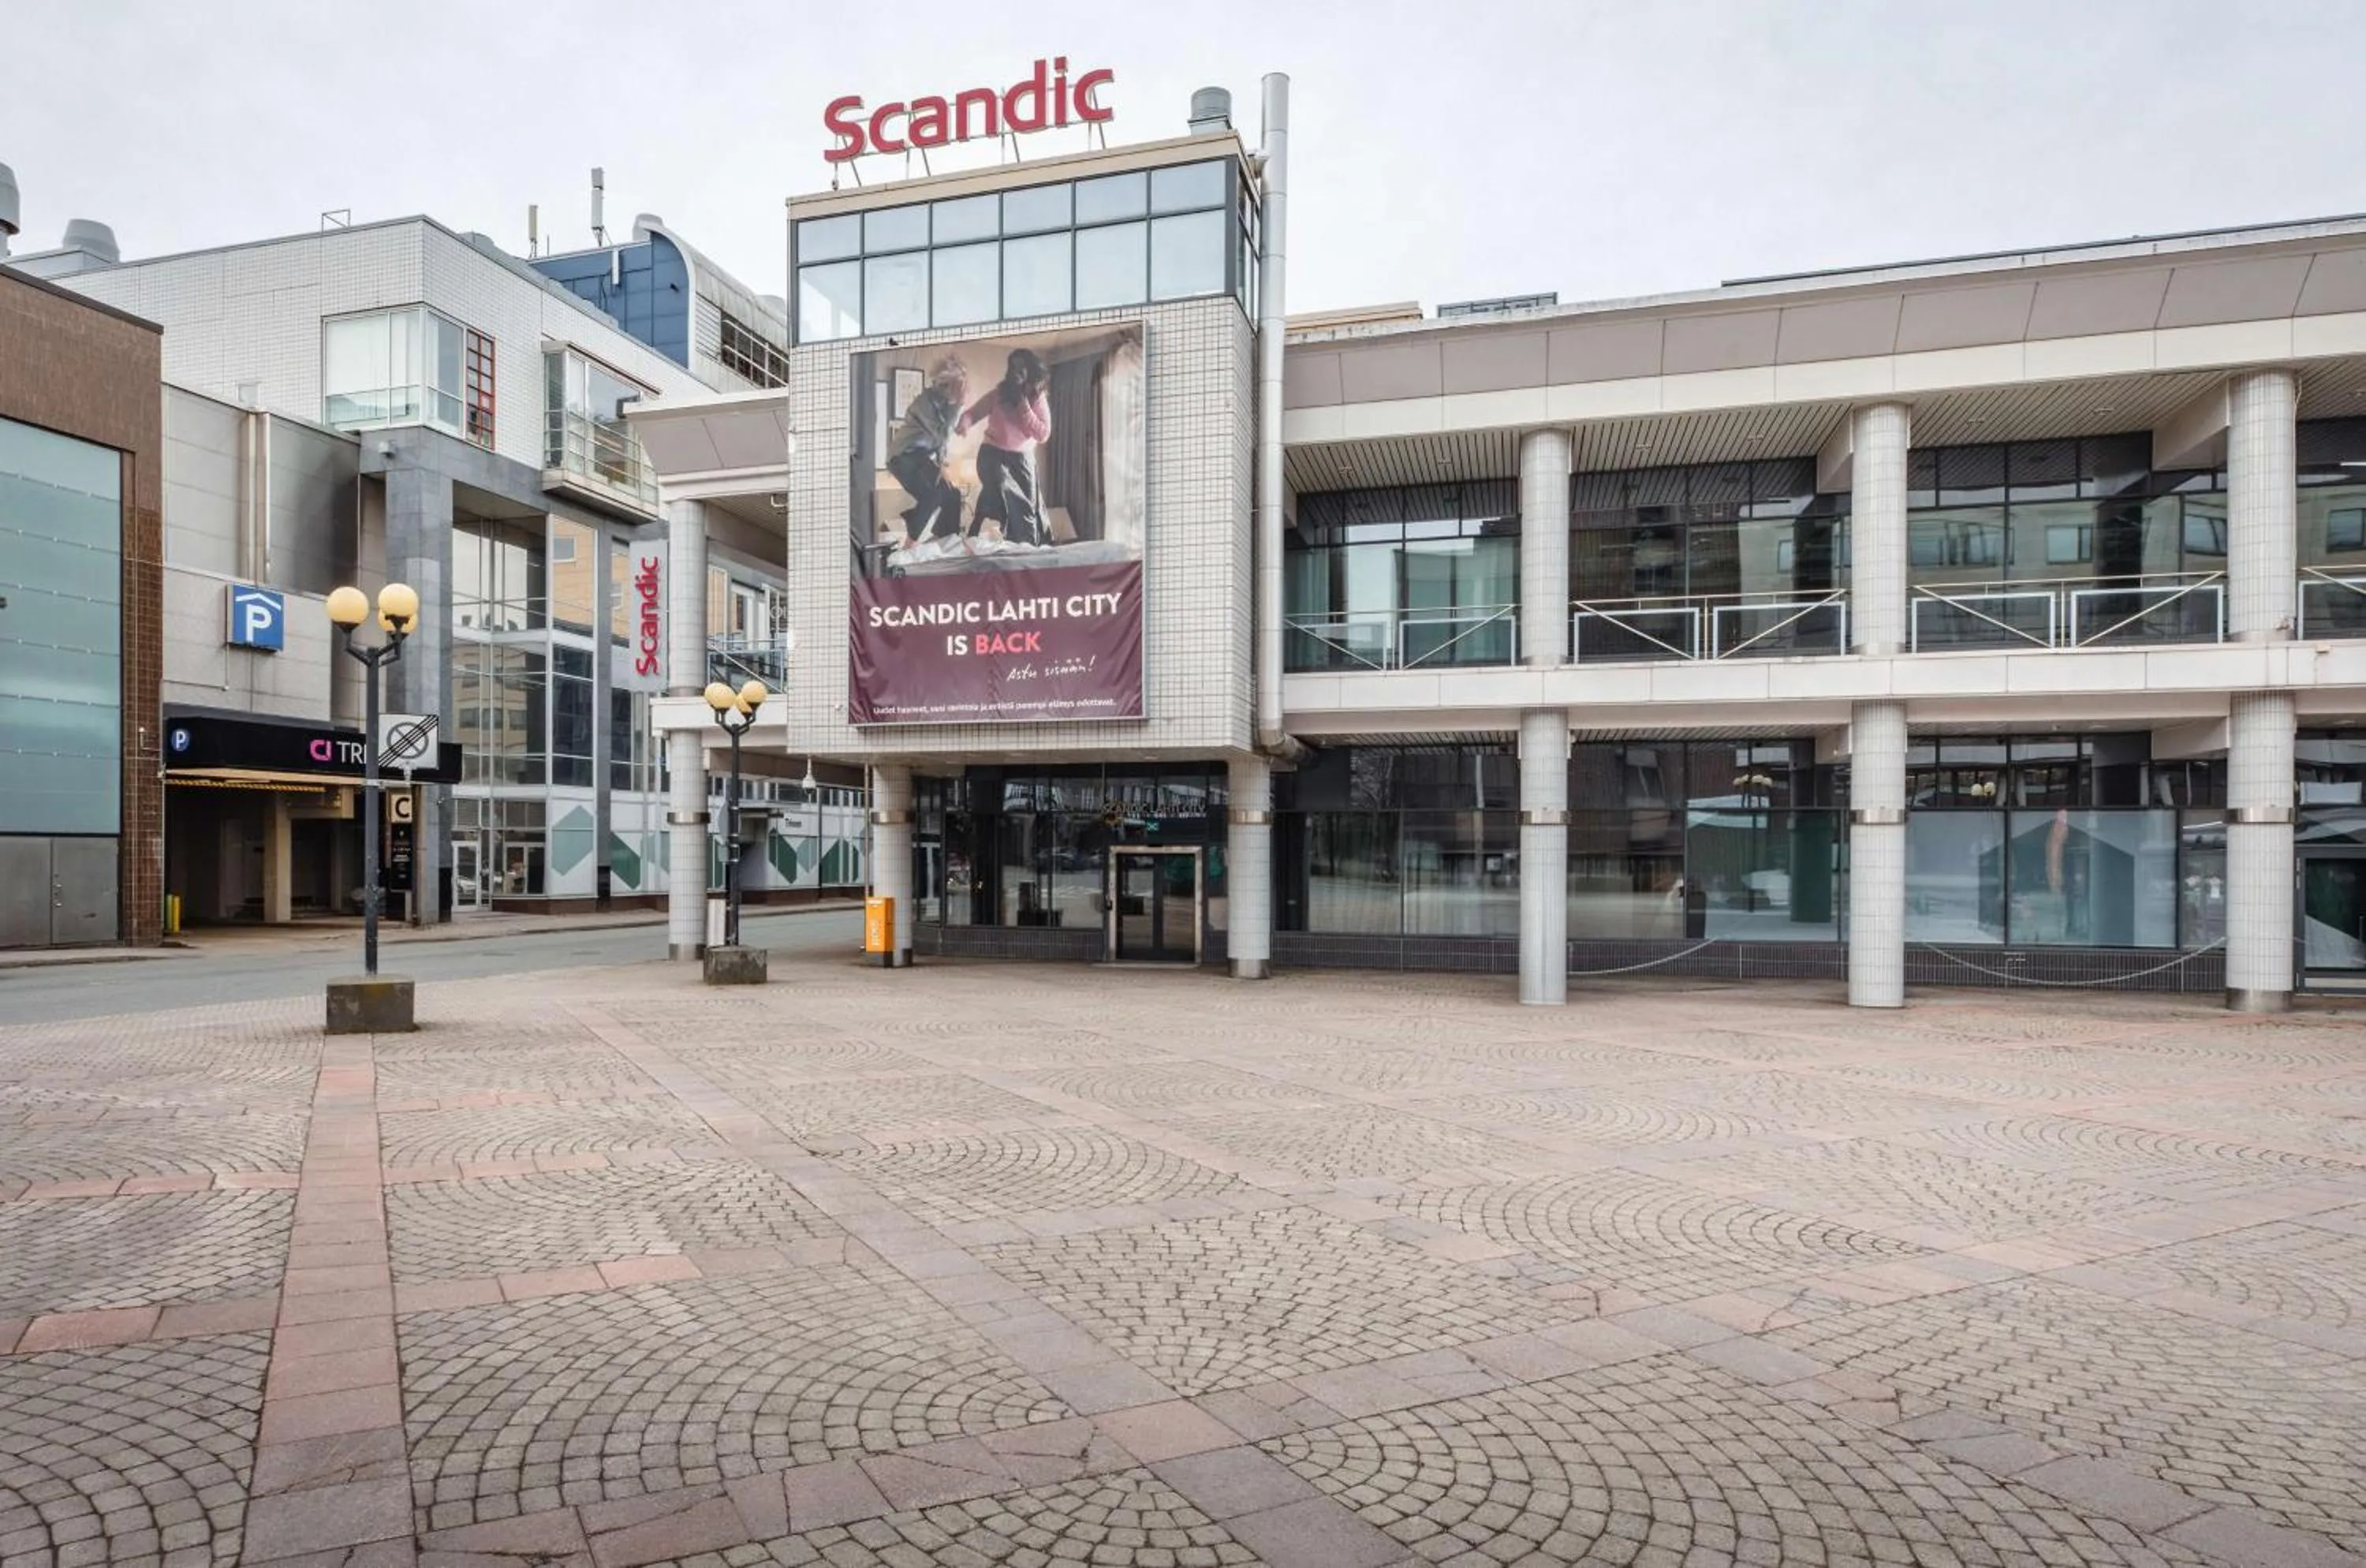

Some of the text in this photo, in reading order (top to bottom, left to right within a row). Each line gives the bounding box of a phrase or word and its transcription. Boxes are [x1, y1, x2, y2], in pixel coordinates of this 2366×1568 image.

[824, 57, 1114, 162] Scandic
[247, 604, 272, 642] P
[636, 555, 659, 677] Scandic
[869, 592, 1122, 628] SCANDIC LAHTI CITY
[946, 630, 1042, 656] IS BACK
[176, 732, 185, 749] P
[335, 740, 367, 764] TRI
[395, 797, 410, 818] C
